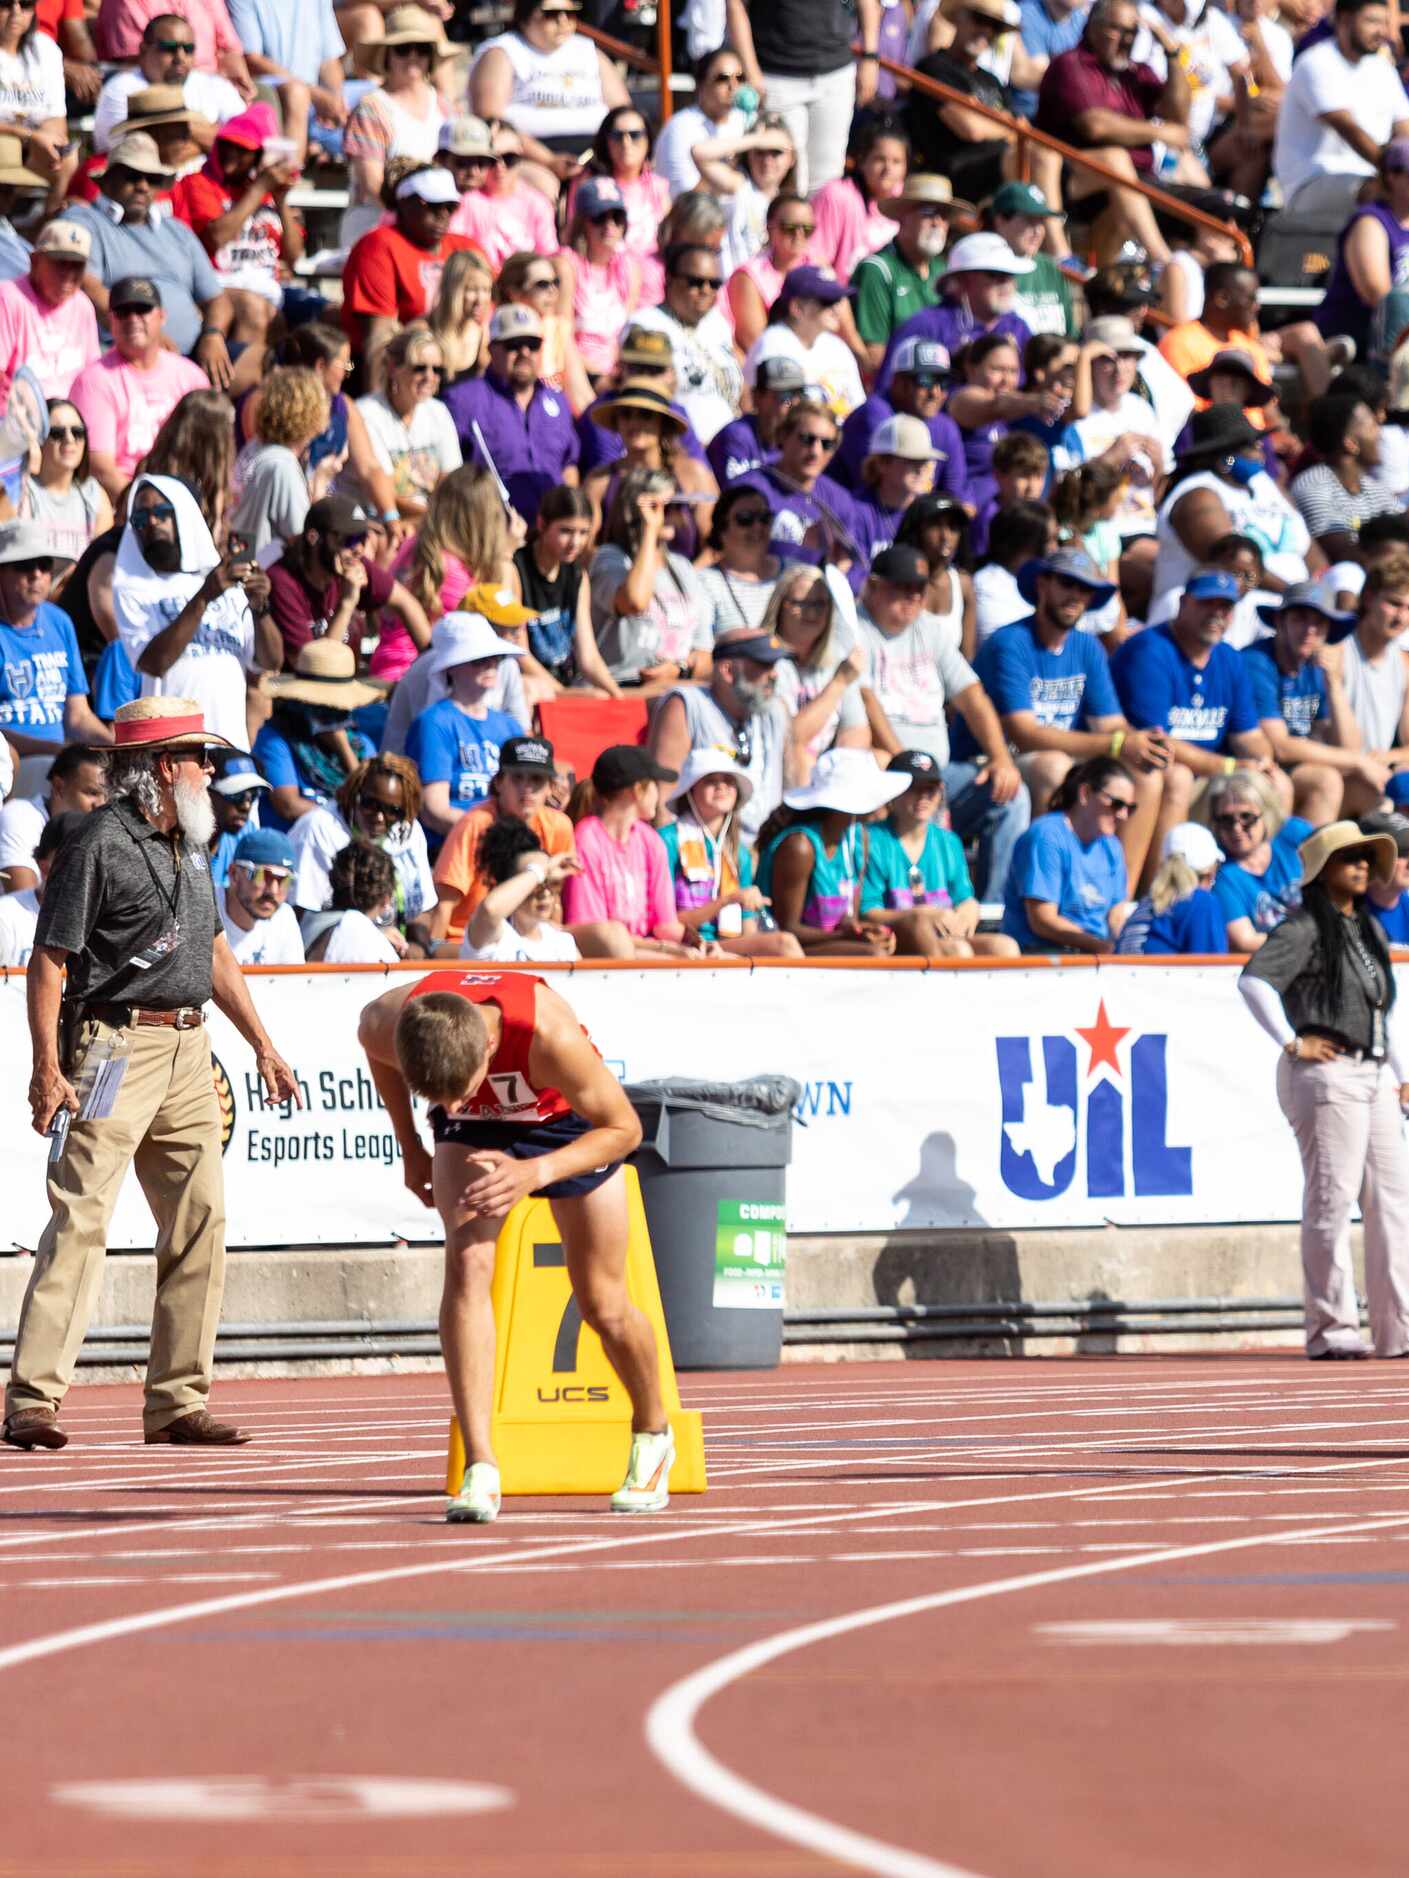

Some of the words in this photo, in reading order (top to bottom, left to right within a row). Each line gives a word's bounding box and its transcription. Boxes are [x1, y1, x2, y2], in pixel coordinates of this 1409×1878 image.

[488, 1075, 519, 1104] 7
[247, 1129, 334, 1168] Esports
[343, 1129, 404, 1166] Leag
[532, 1242, 585, 1373] 7
[537, 1386, 610, 1403] UCS
